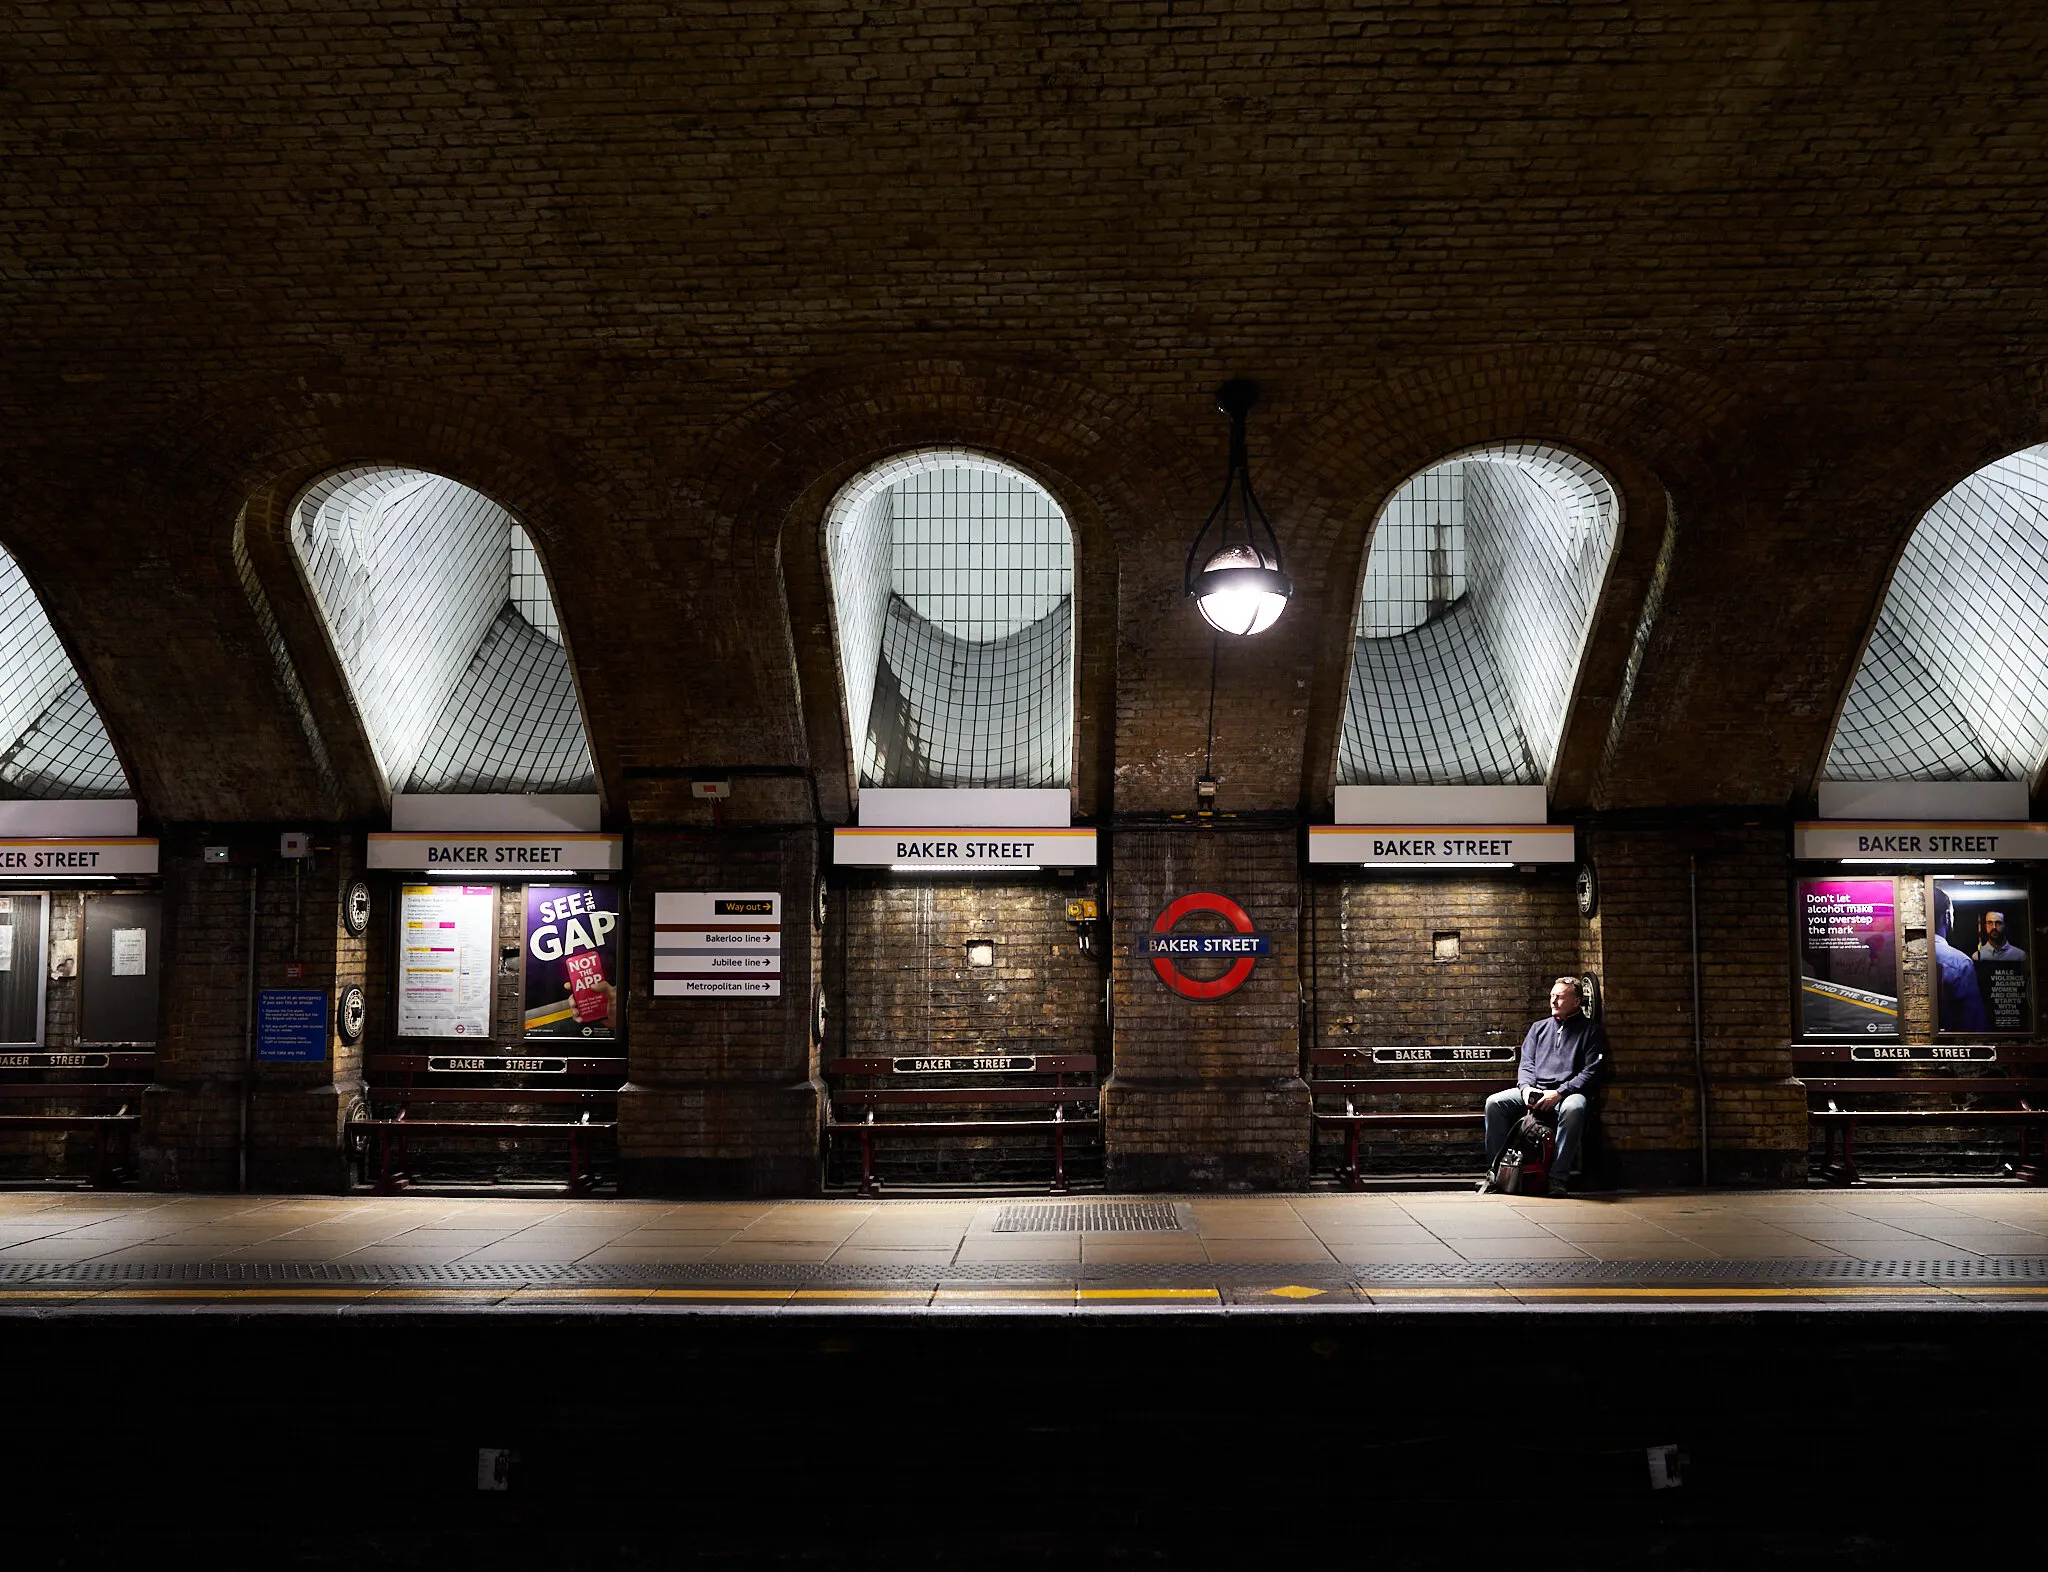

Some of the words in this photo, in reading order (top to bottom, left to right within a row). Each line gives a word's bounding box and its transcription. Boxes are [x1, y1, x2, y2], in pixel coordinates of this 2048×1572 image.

[1373, 841, 1436, 855] BAKER
[1443, 841, 1512, 855] STREET
[1859, 836, 1922, 852] BAKER
[1929, 836, 1998, 852] STREET
[428, 847, 488, 862] BAKER
[495, 847, 562, 862] STREET
[897, 843, 958, 858] BAKER
[965, 843, 1034, 858] STREET
[34, 852, 99, 867] STREET
[583, 890, 596, 912] THE
[1807, 894, 1834, 902] Don't
[1836, 894, 1851, 902] let
[539, 893, 585, 923] SEE
[726, 903, 745, 912] Way
[1808, 905, 1844, 913] alcohol
[1847, 905, 1873, 913] make
[1808, 917, 1826, 925] you
[1829, 915, 1873, 925] overstep
[1808, 926, 1825, 934] the
[1828, 926, 1854, 934] mark
[530, 911, 616, 961] GAP
[1149, 940, 1199, 952] BAKER
[1204, 939, 1259, 951] STREET
[568, 955, 597, 972] NOT
[579, 968, 593, 977] THE
[575, 974, 602, 991] APP
[687, 983, 742, 991] Metropolitan
[1811, 983, 1837, 993] MIND
[1839, 990, 1860, 999] THE
[1863, 996, 1888, 1006] GAP
[1395, 1051, 1432, 1059] BAKER
[1453, 1050, 1491, 1059] STREET
[1874, 1049, 1910, 1057] BAKER
[1932, 1049, 1971, 1057] STREET
[50, 1056, 86, 1064] STREET
[450, 1060, 485, 1068] BAKER
[506, 1061, 543, 1069] STREET
[915, 1060, 951, 1069] BAKER
[973, 1059, 1011, 1068] STREET
